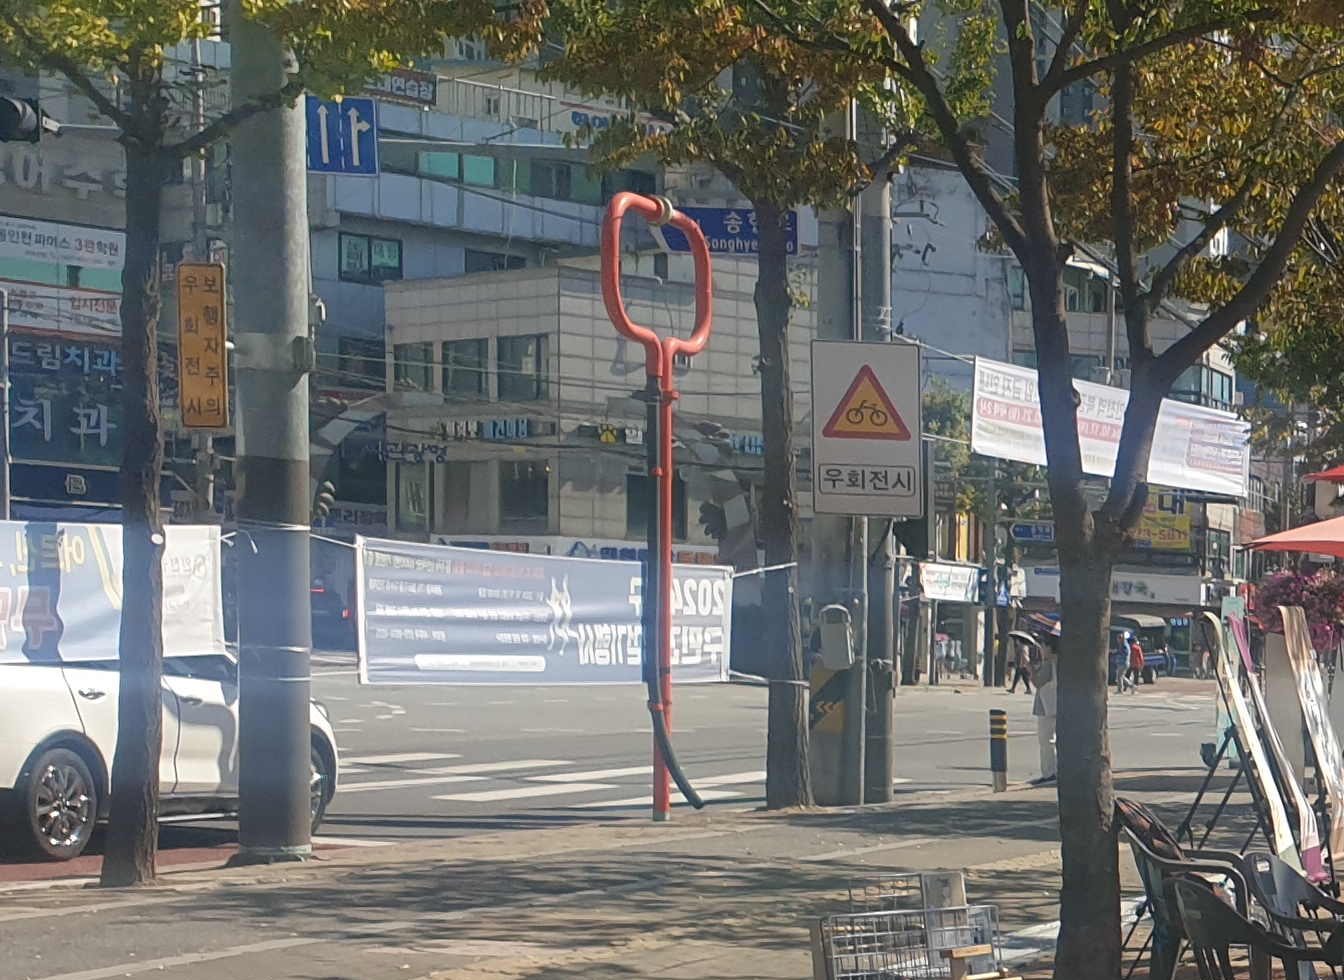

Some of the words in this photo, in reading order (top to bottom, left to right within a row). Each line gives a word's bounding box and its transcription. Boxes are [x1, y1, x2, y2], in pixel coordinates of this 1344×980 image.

[183, 275, 201, 417] 우회전시
[203, 276, 221, 415] 보행자주의
[822, 467, 912, 492] 우회전시
